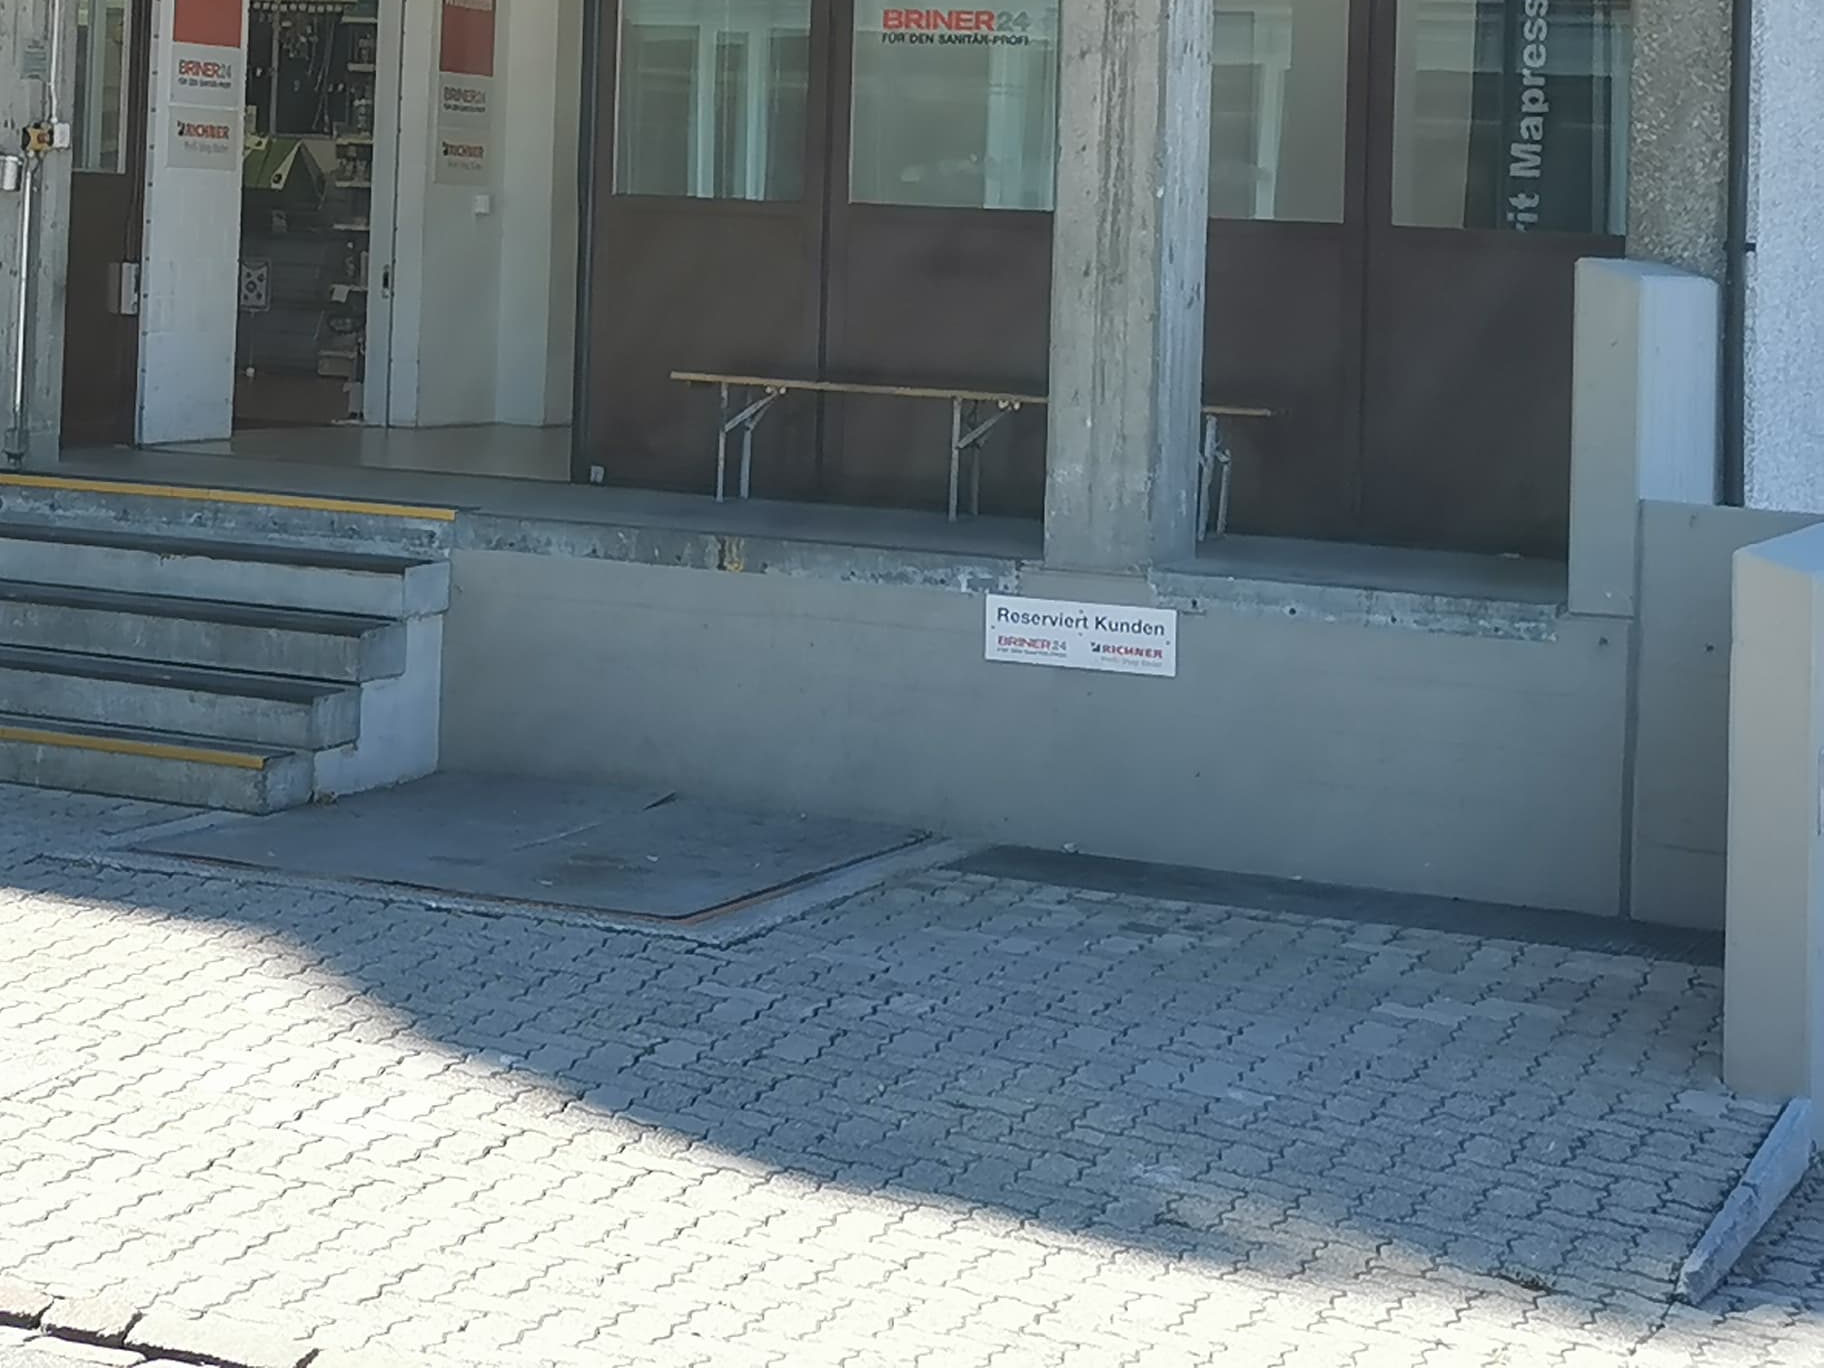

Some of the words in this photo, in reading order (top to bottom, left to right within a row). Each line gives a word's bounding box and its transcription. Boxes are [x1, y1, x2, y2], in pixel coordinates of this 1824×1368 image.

[882, 9, 1031, 32] BRINER24
[909, 33, 934, 44] DEN
[997, 607, 1089, 629] Reserviert
[1095, 616, 1164, 636] Kunden
[997, 635, 1067, 651] BRINER24
[1102, 645, 1163, 659] RICHNER
